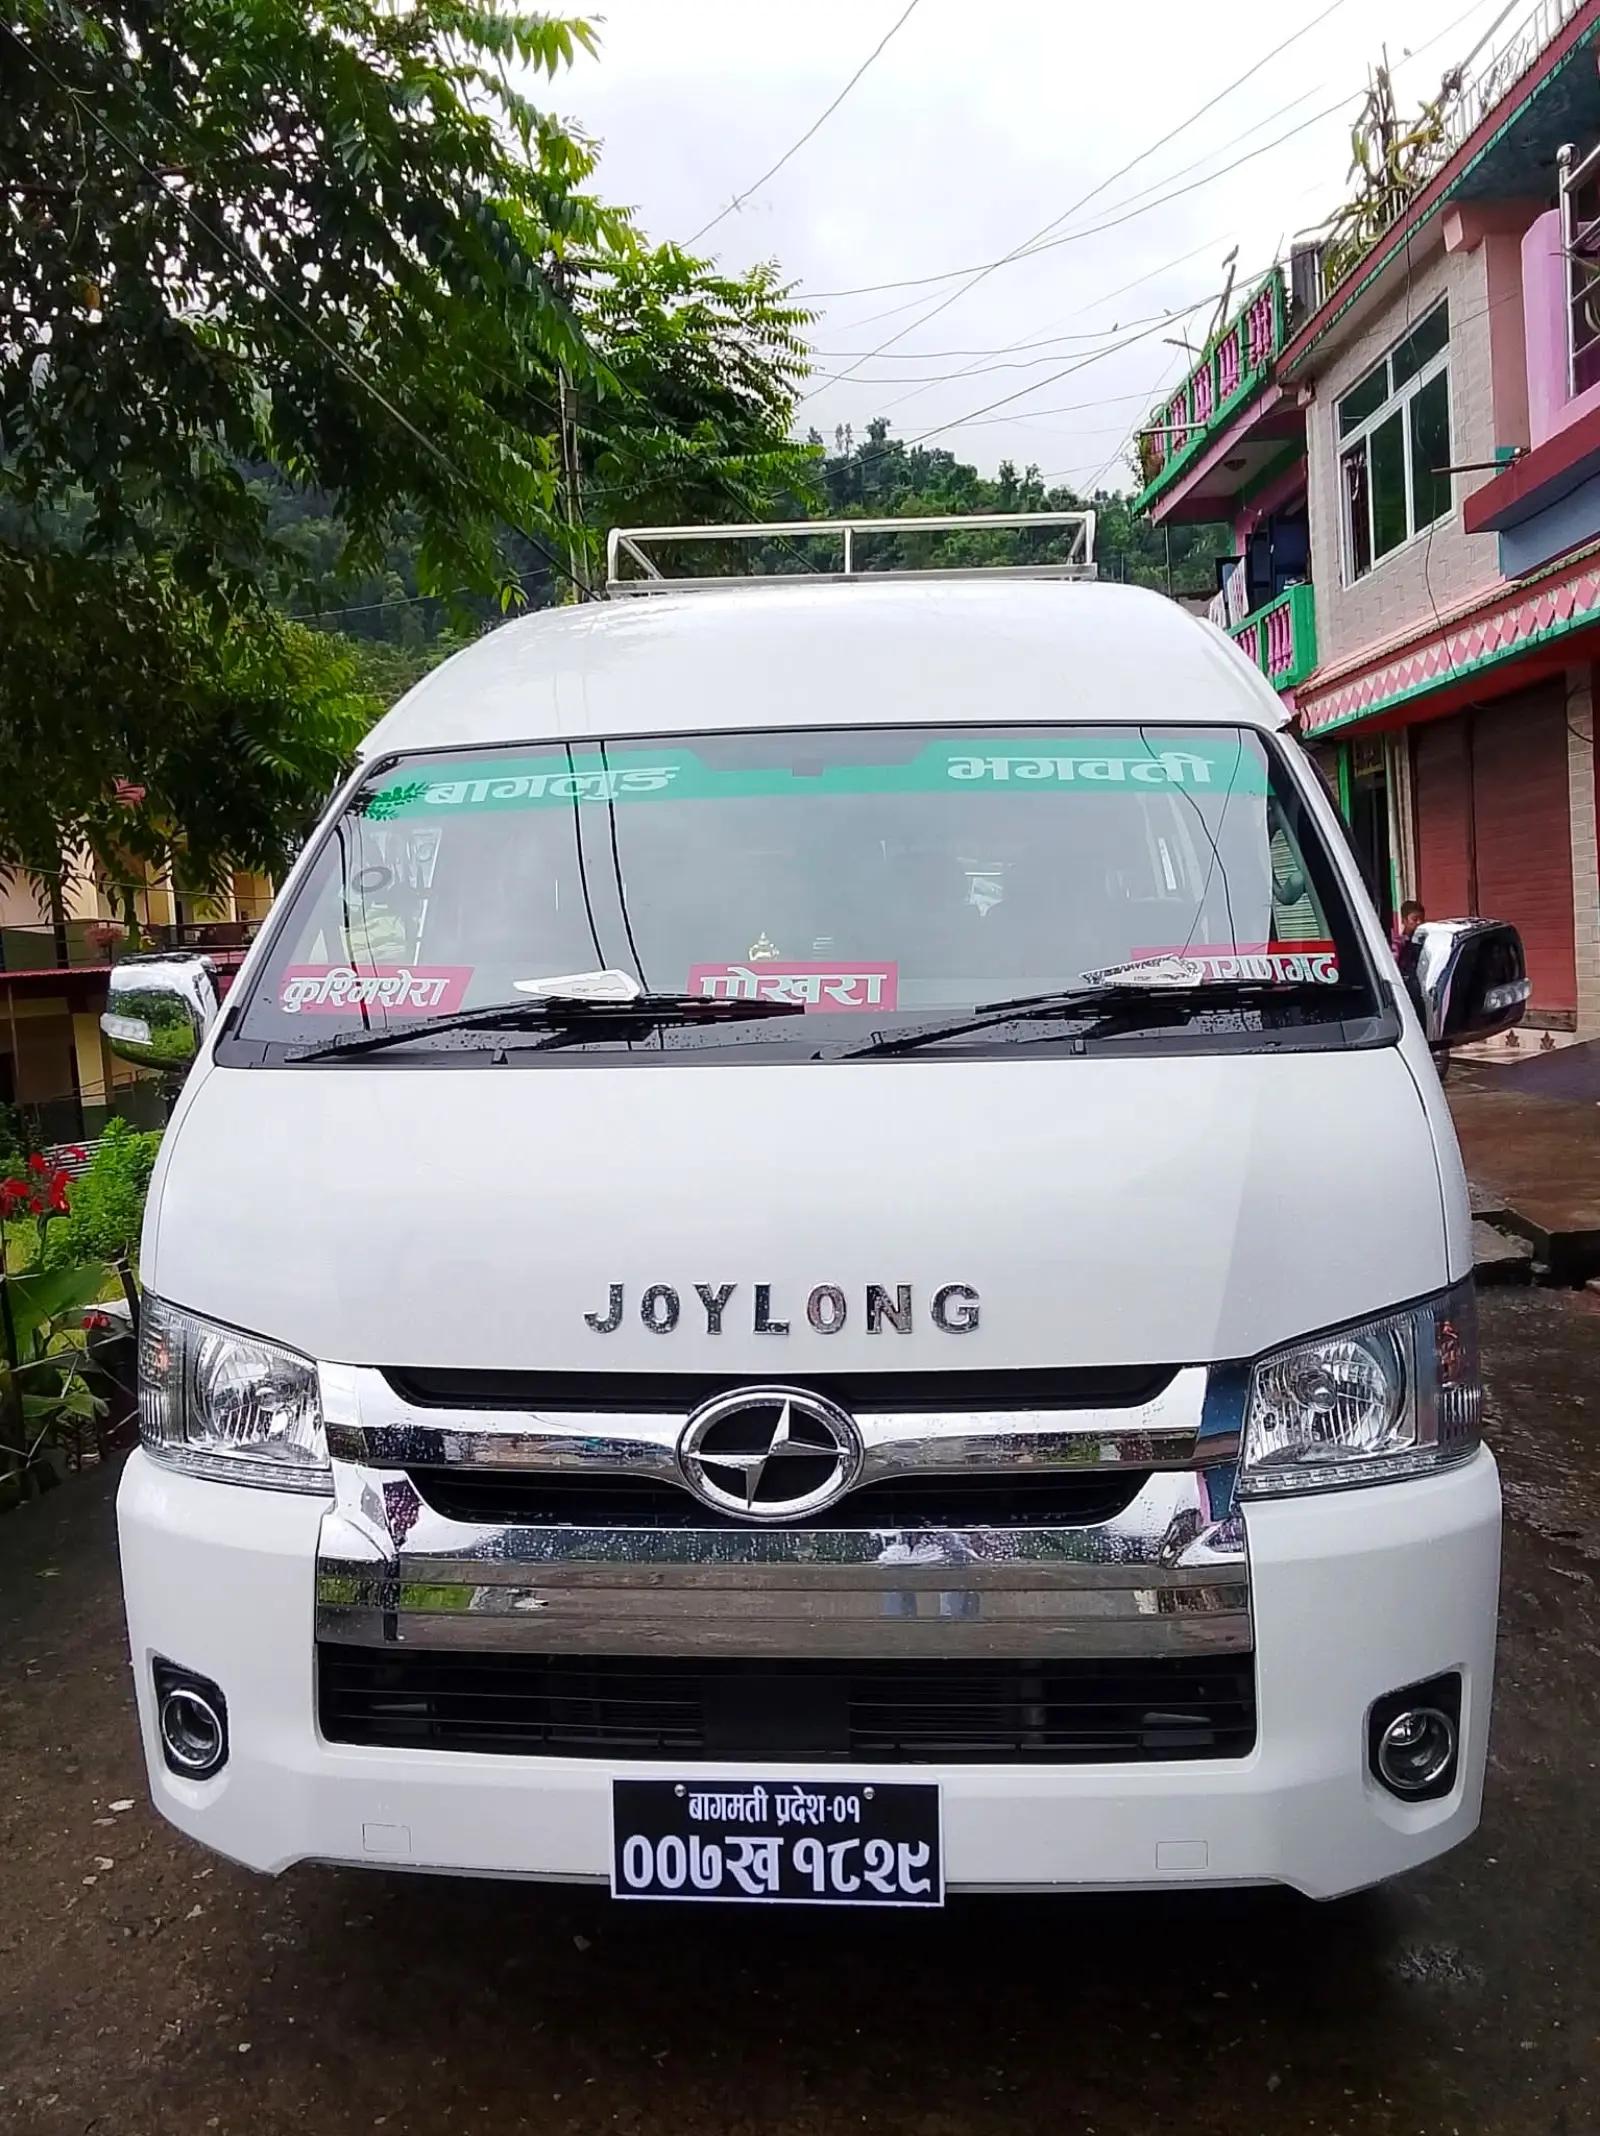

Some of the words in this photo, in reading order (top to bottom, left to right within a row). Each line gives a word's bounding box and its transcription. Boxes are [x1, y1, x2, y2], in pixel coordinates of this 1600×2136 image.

[947, 751, 1215, 784] भगवती
[700, 966, 888, 1006] पोखरा
[583, 1281, 981, 1335] JOYLONG
[688, 1785, 769, 1823] बागमती
